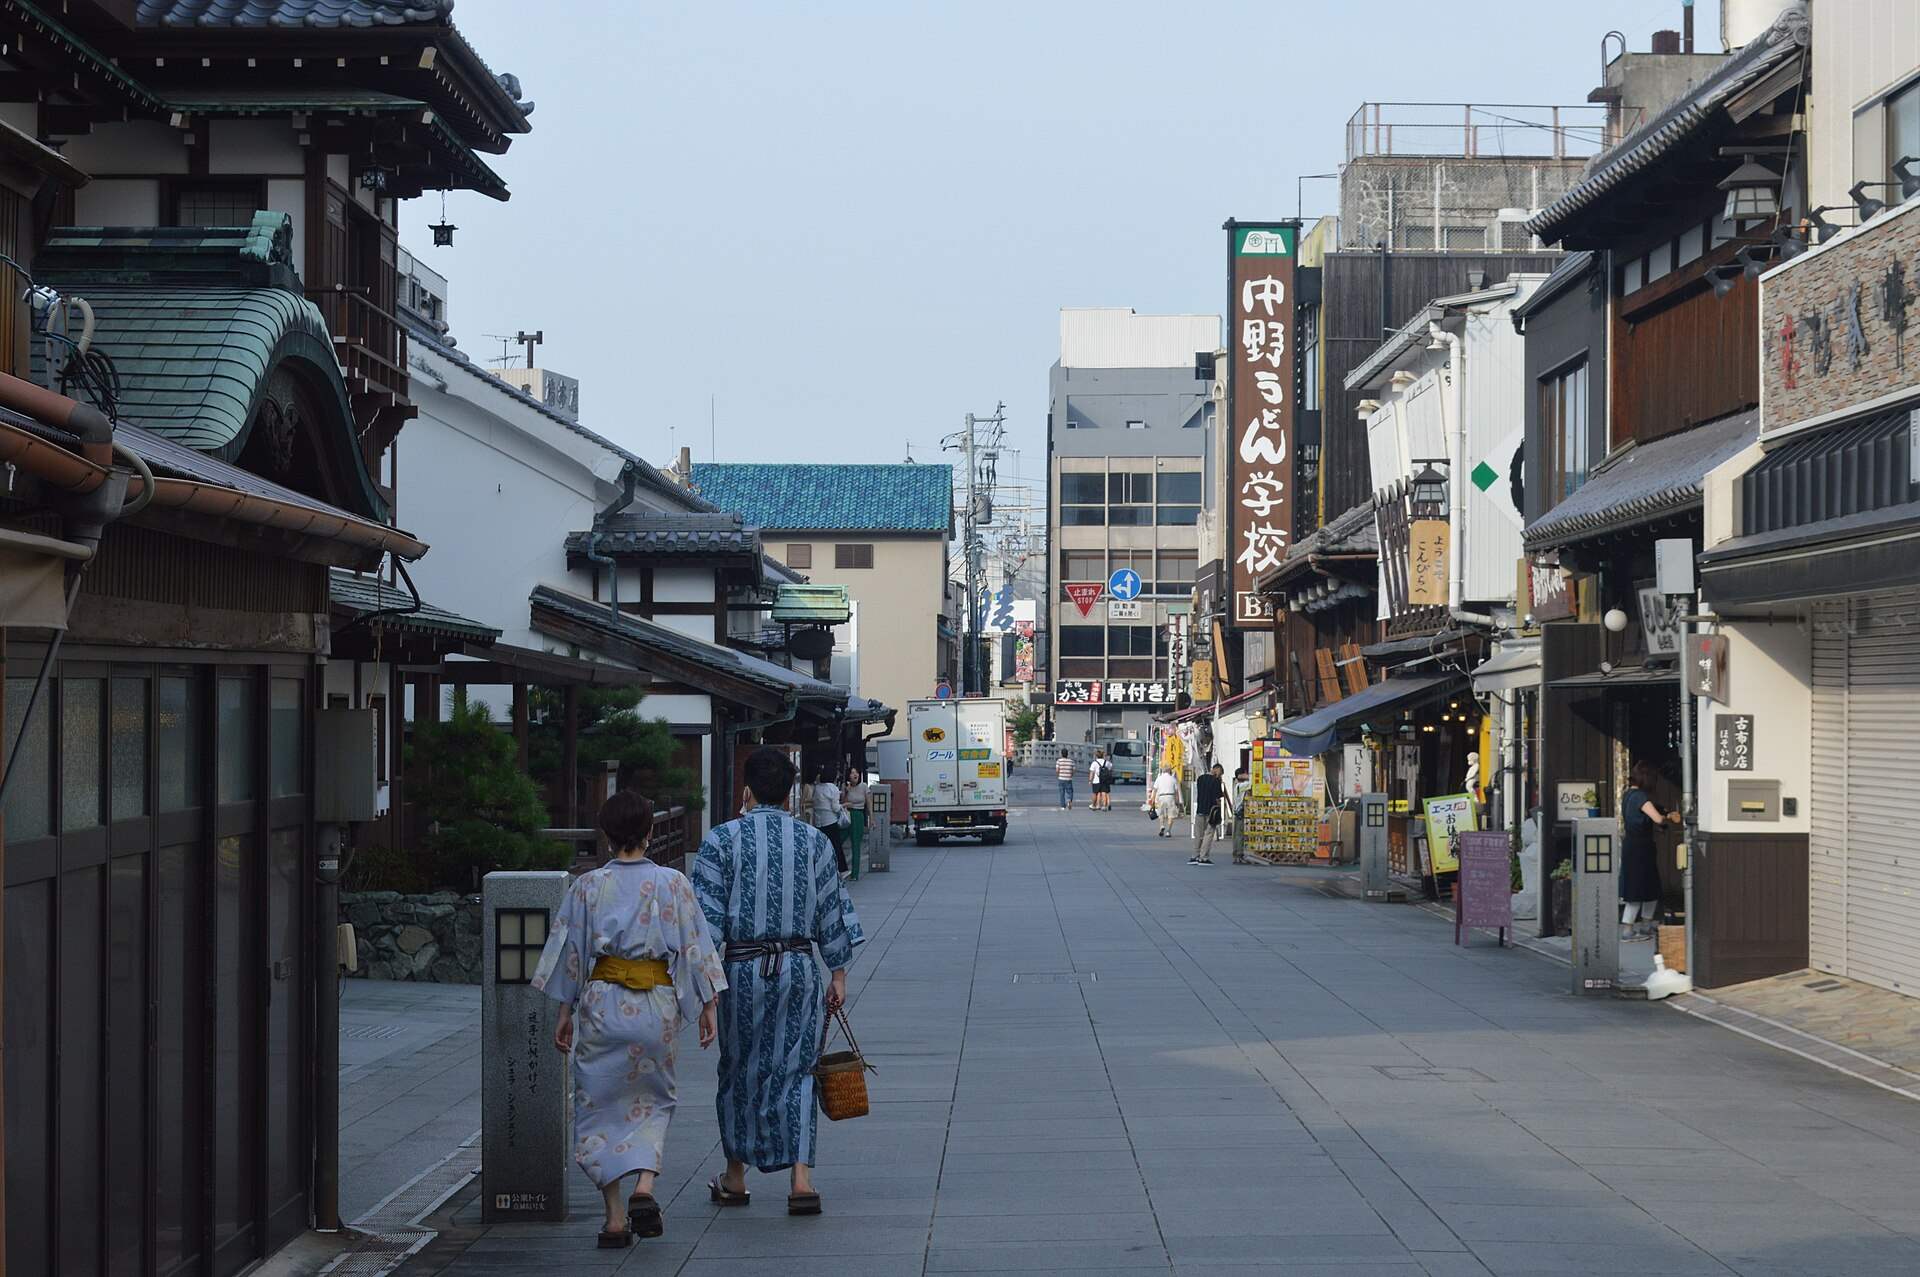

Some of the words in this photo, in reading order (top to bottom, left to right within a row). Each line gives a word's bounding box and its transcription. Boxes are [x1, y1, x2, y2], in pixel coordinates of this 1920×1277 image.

[1236, 274, 1288, 574] 中野うどん学校
[1058, 689, 1089, 703] かき
[929, 751, 954, 760] クール
[1719, 730, 1729, 767] ほそかわ
[1733, 717, 1749, 769] 古布の店
